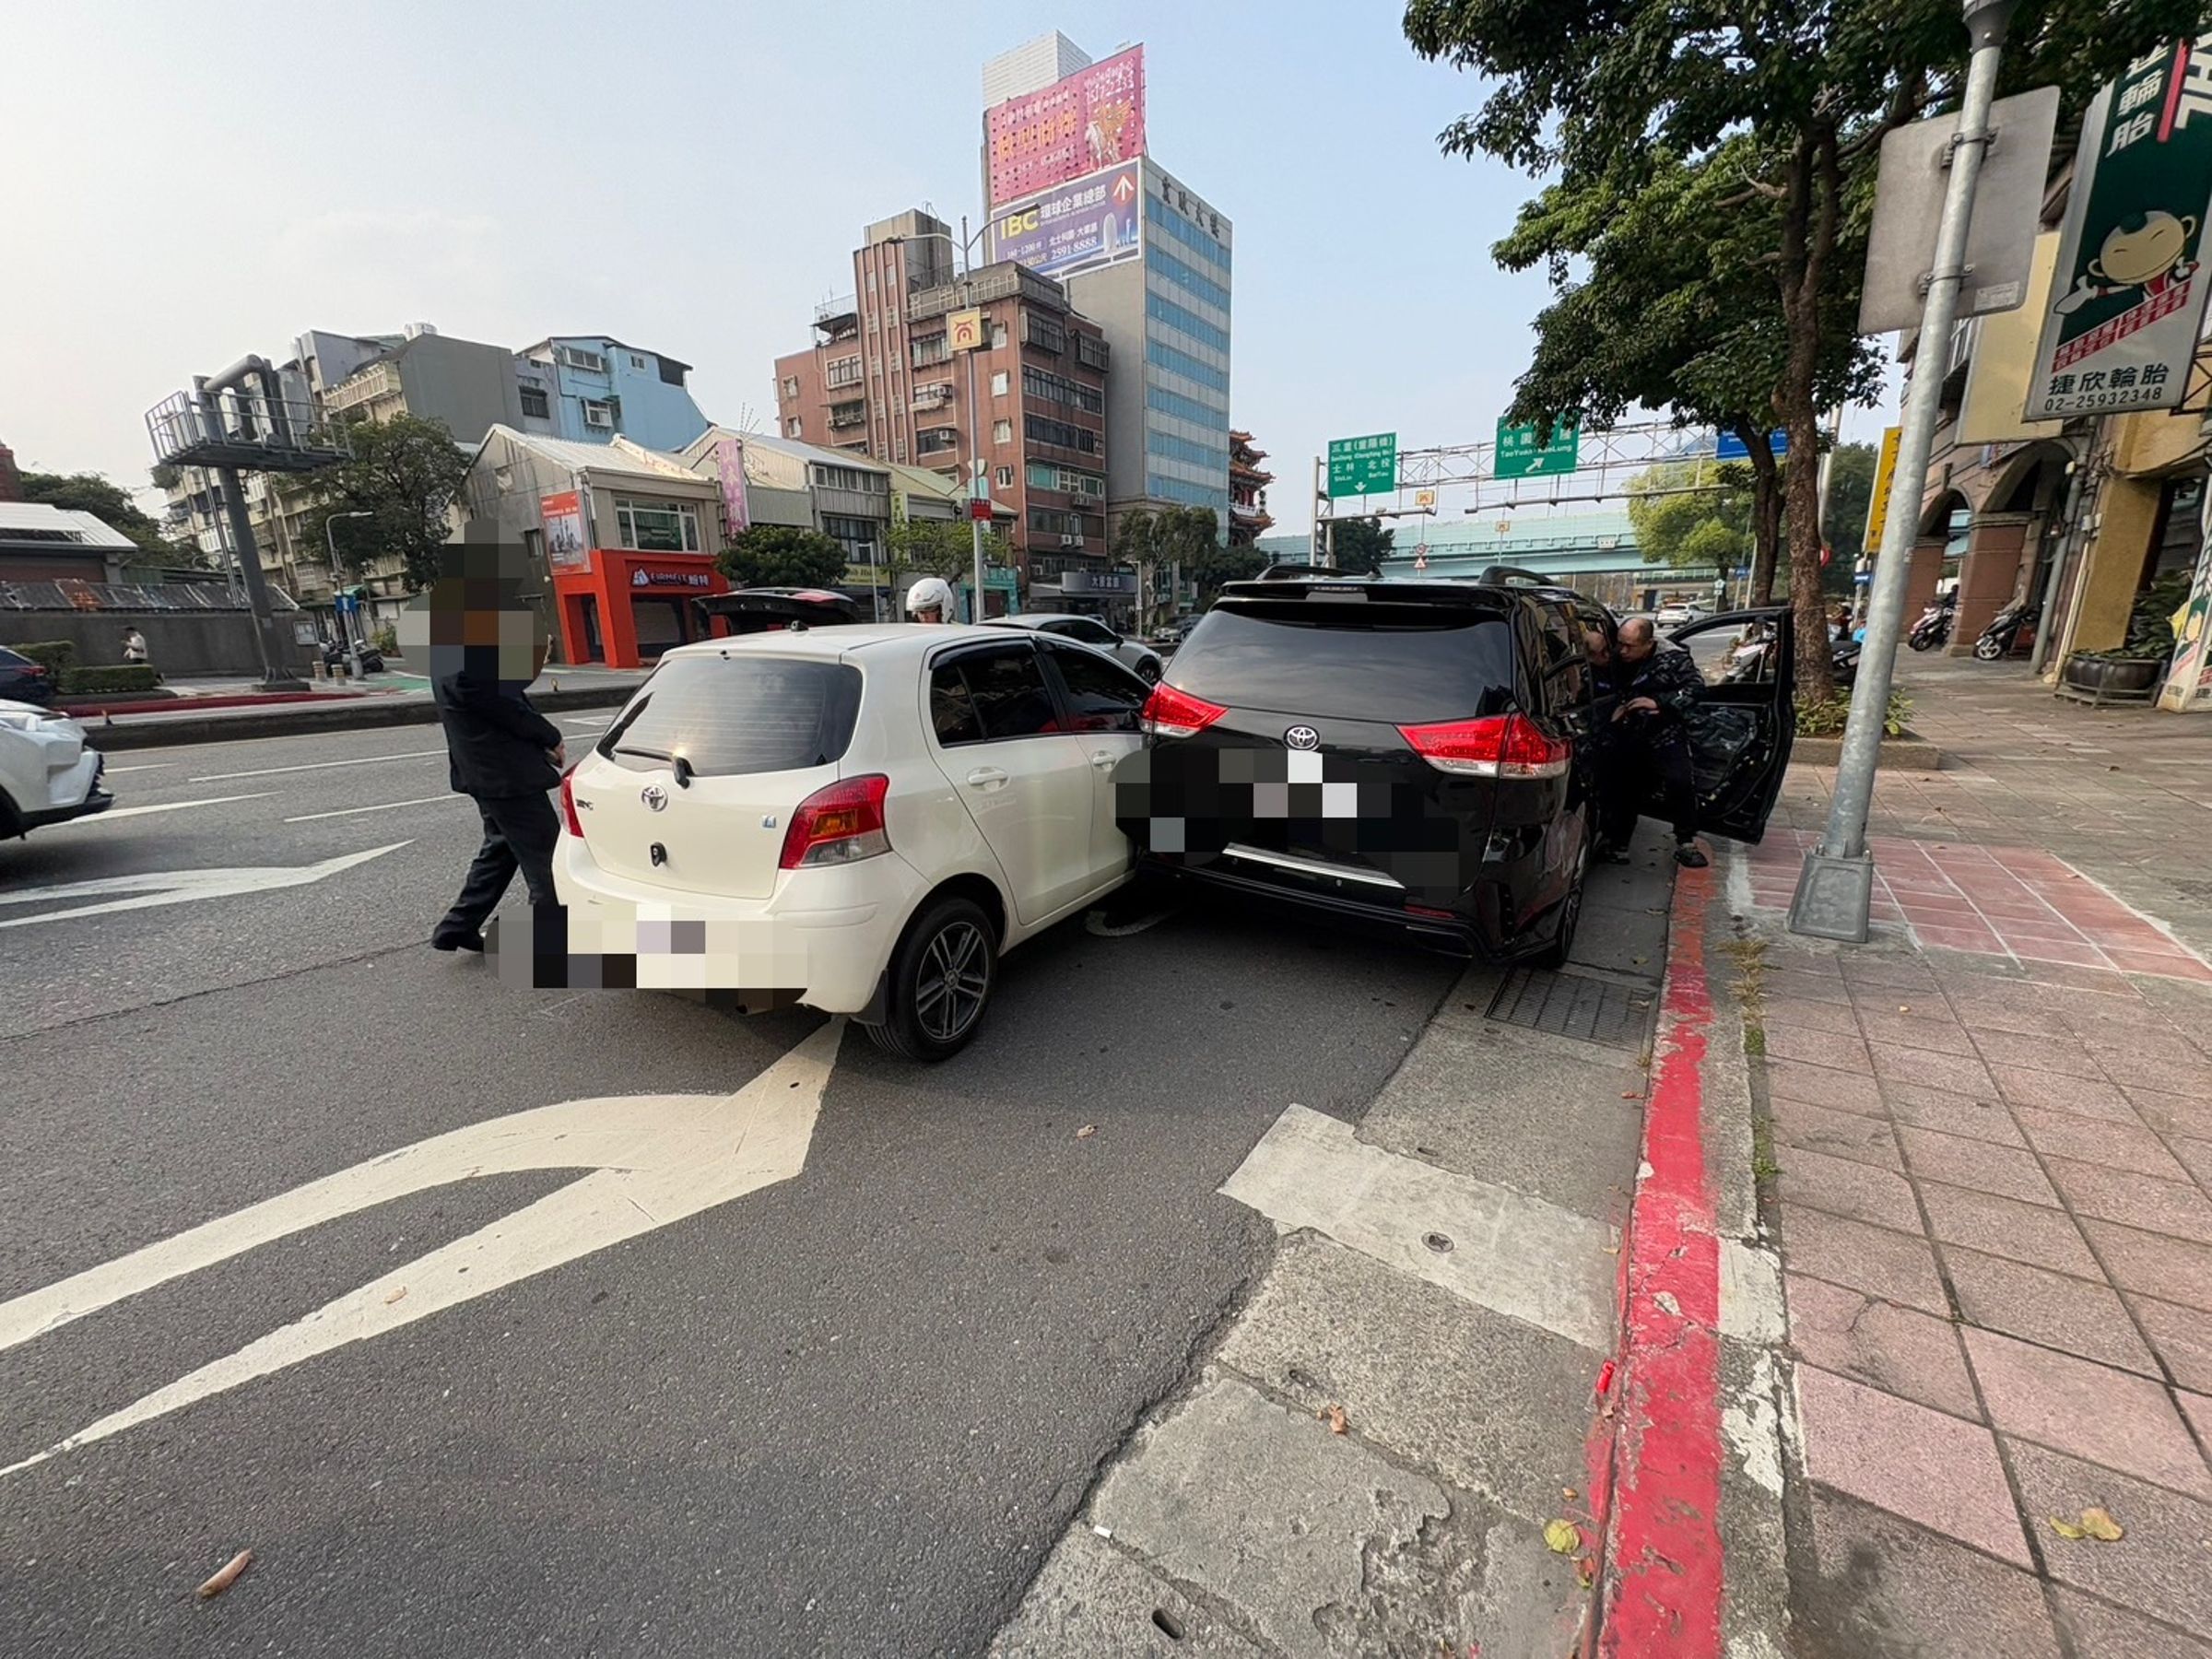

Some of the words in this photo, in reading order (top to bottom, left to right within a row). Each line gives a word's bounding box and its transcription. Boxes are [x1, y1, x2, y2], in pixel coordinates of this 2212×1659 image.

[1001, 210, 1039, 240] IBC
[2048, 363, 2170, 396] 捷欣輪胎
[2044, 387, 2162, 411] 02-25932348
